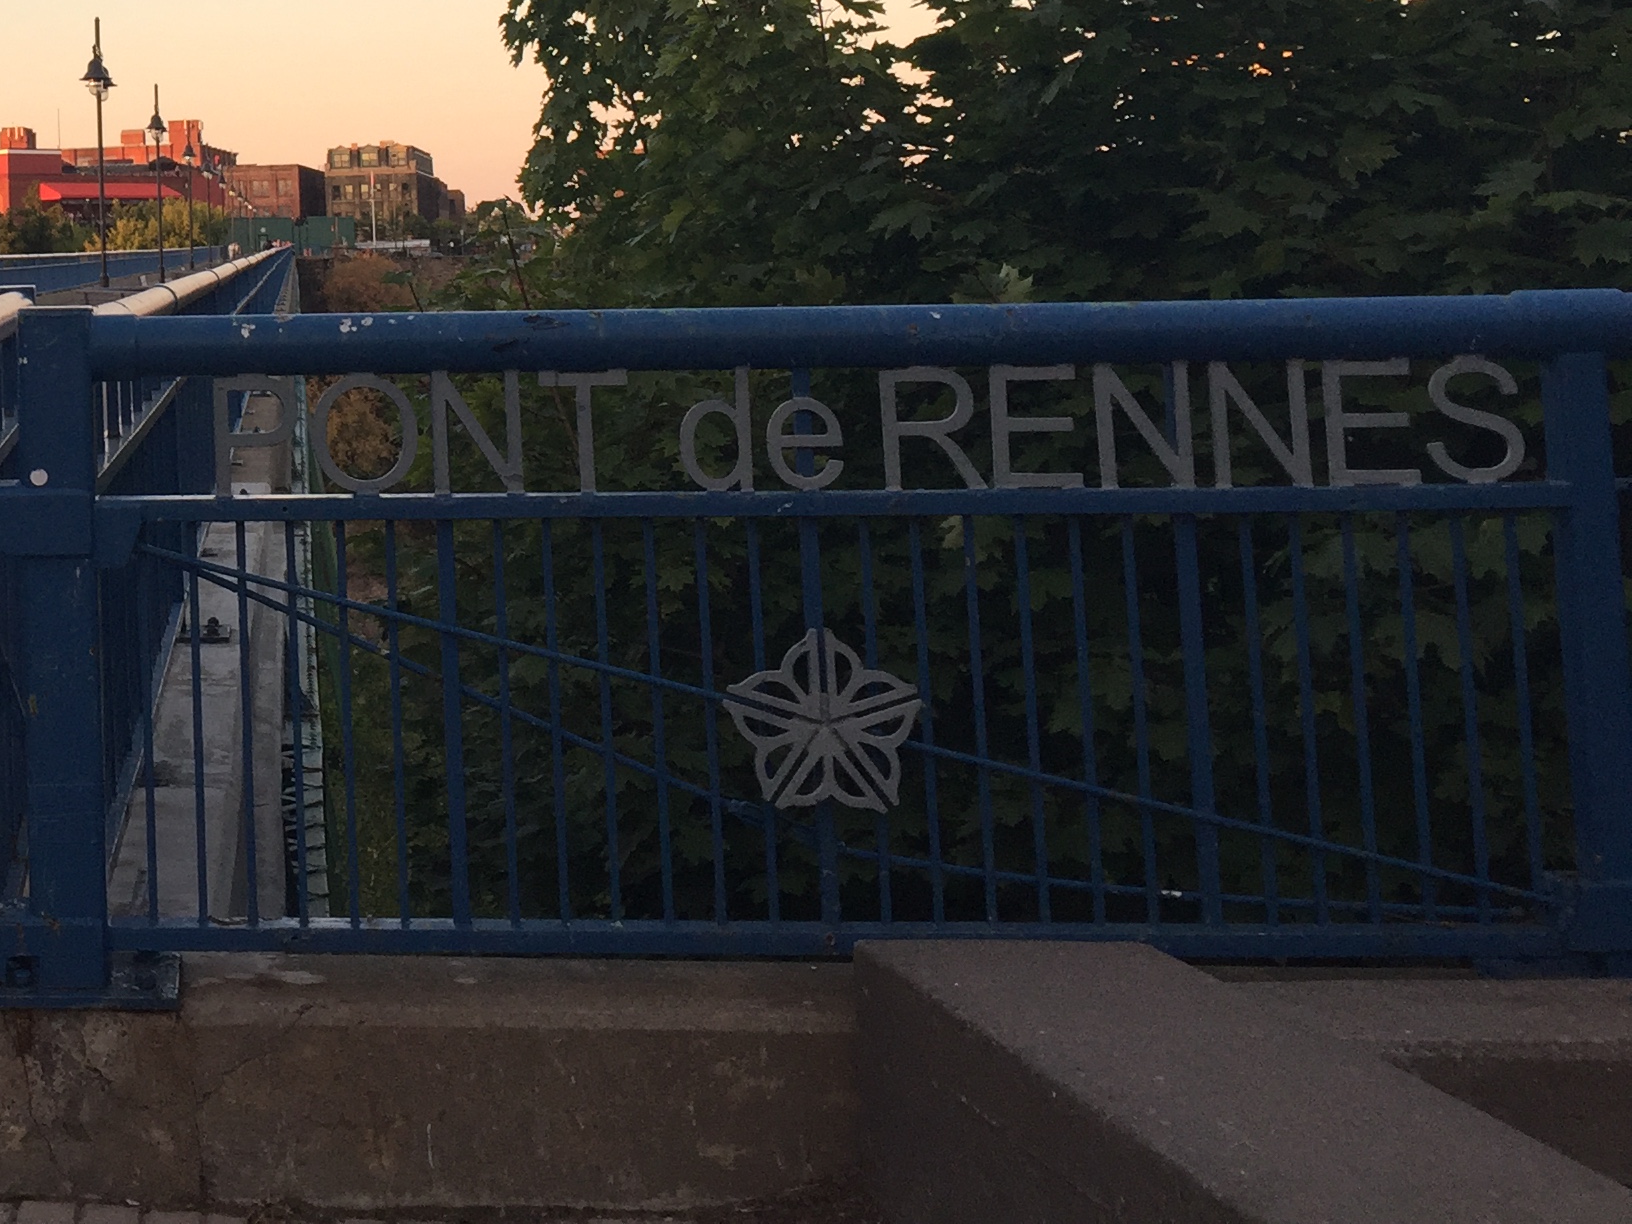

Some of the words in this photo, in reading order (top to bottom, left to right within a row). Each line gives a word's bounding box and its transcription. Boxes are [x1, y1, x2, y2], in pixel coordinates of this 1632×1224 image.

[213, 369, 628, 497] PONT
[679, 365, 844, 490] de
[878, 354, 1526, 491] RENNES
